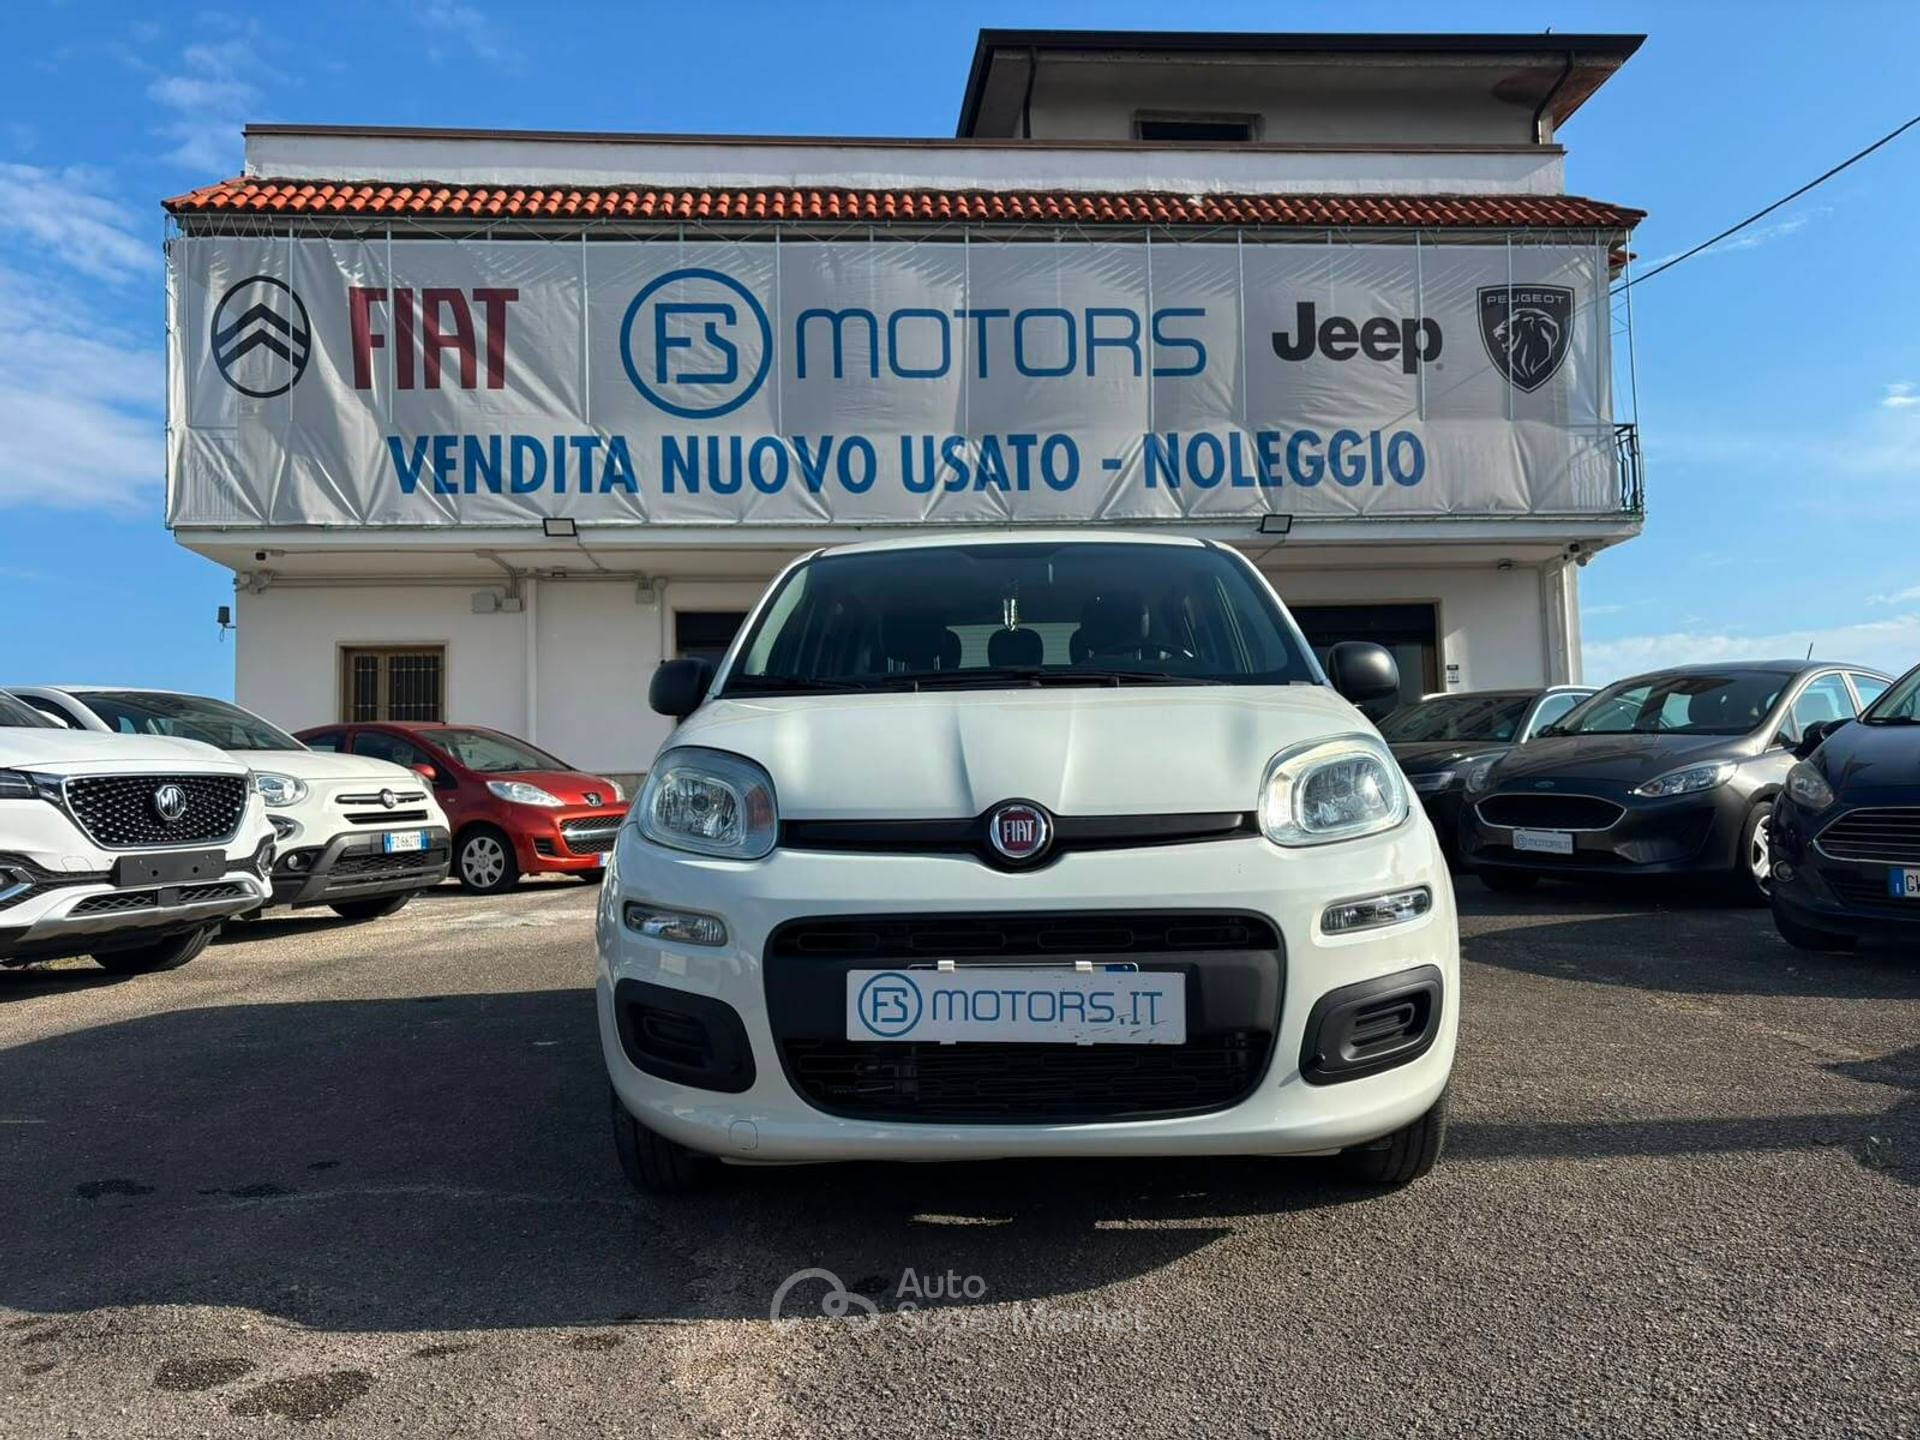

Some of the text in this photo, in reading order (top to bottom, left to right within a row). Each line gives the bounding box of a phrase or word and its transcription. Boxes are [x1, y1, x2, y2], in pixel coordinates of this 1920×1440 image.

[1486, 293, 1566, 304] PEUGEOT
[349, 285, 519, 390] FIAT
[796, 307, 1207, 379] MOTORS
[1272, 301, 1442, 374] Jeep
[388, 434, 637, 496] VENDITA
[662, 434, 877, 495] NUOVO
[901, 432, 1080, 494] USATO
[1143, 429, 1426, 490] NOLEGGIO
[1003, 819, 1034, 843] FIAT
[932, 990, 1164, 1026] MOTORS.IT
